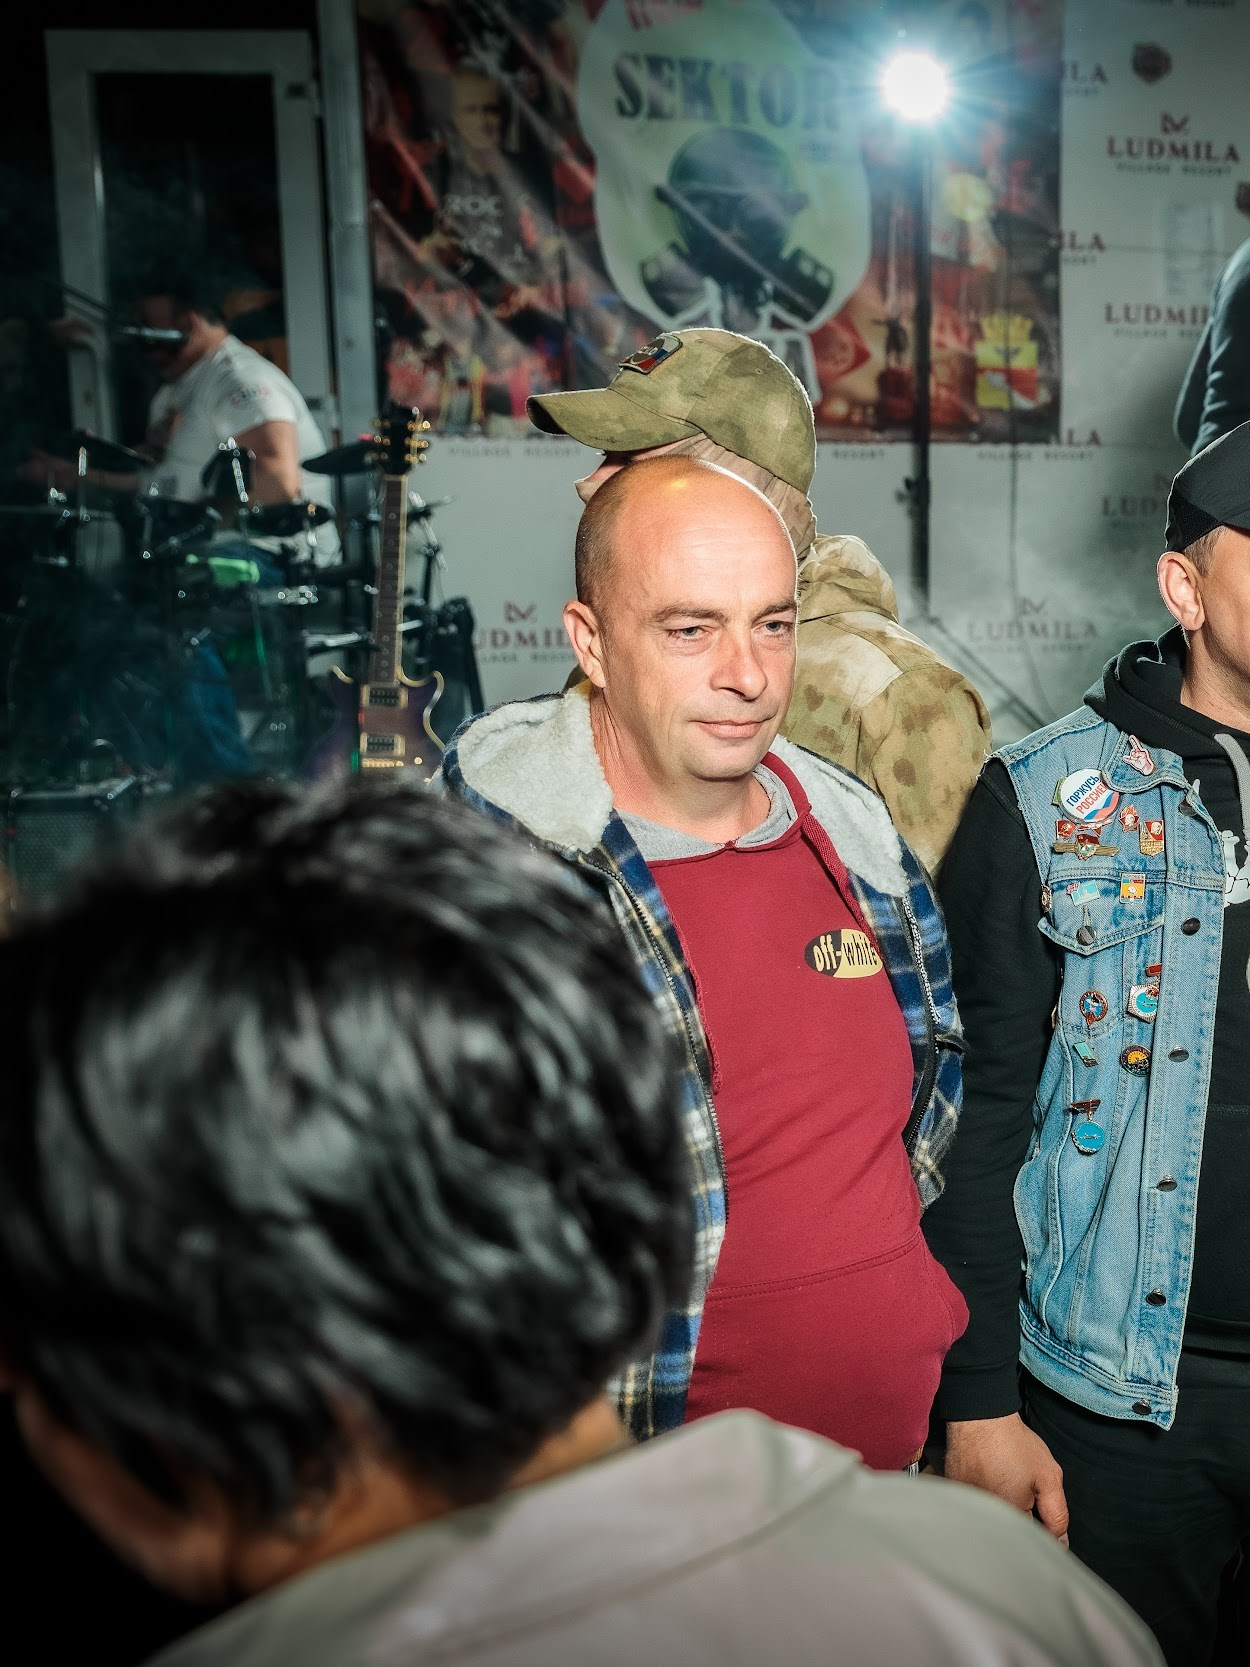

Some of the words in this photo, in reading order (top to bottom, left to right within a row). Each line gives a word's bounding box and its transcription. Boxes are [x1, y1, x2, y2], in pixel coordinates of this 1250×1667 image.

[613, 52, 840, 129] SEKTOR
[1107, 136, 1240, 164] LUDMILA
[1104, 302, 1209, 326] LUDMIL
[968, 621, 1099, 641] LUDMILA
[1066, 775, 1100, 807] ГОРЖУСЬ
